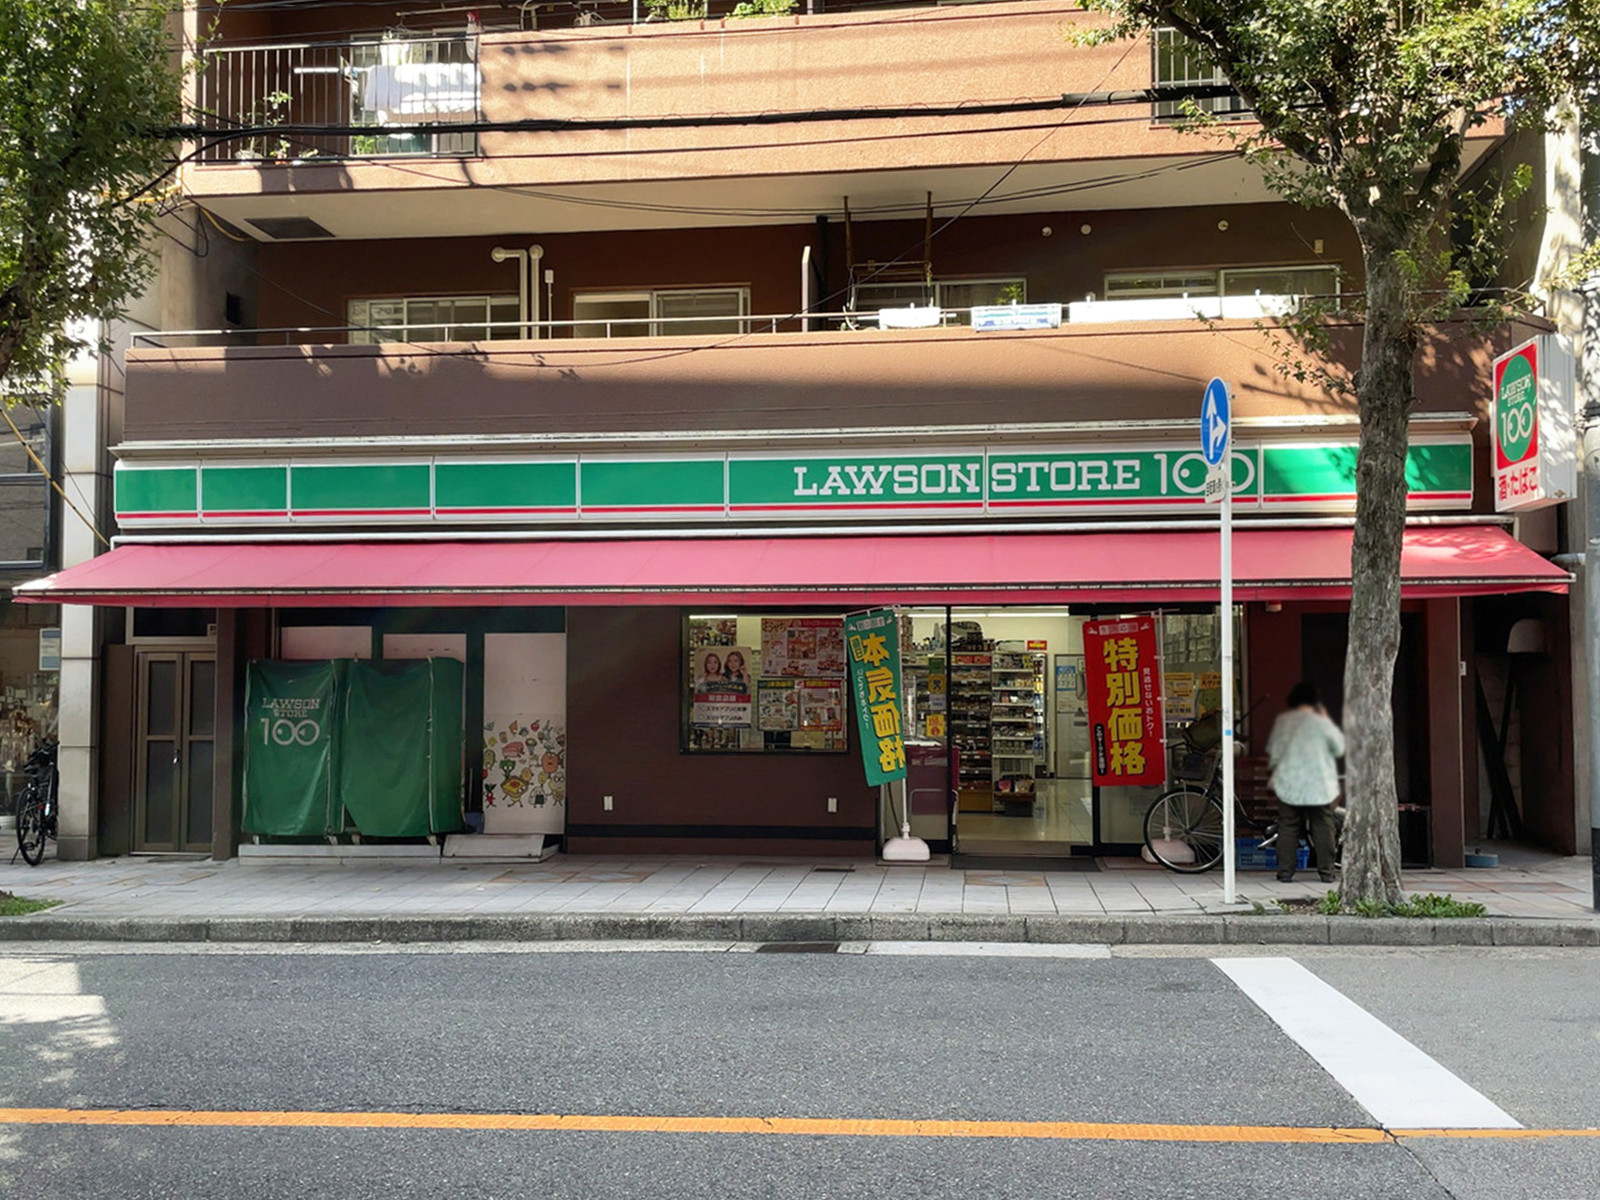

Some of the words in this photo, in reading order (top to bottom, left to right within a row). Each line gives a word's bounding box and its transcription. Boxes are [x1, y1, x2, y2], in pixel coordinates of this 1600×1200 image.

[1501, 372, 1532, 400] LAWSON
[1501, 402, 1533, 448] 100
[793, 462, 981, 496] LAWSON
[991, 459, 1141, 494] STORE
[262, 697, 320, 709] LAWSON
[1103, 637, 1146, 776] 特別価格
[260, 718, 320, 745] 100
